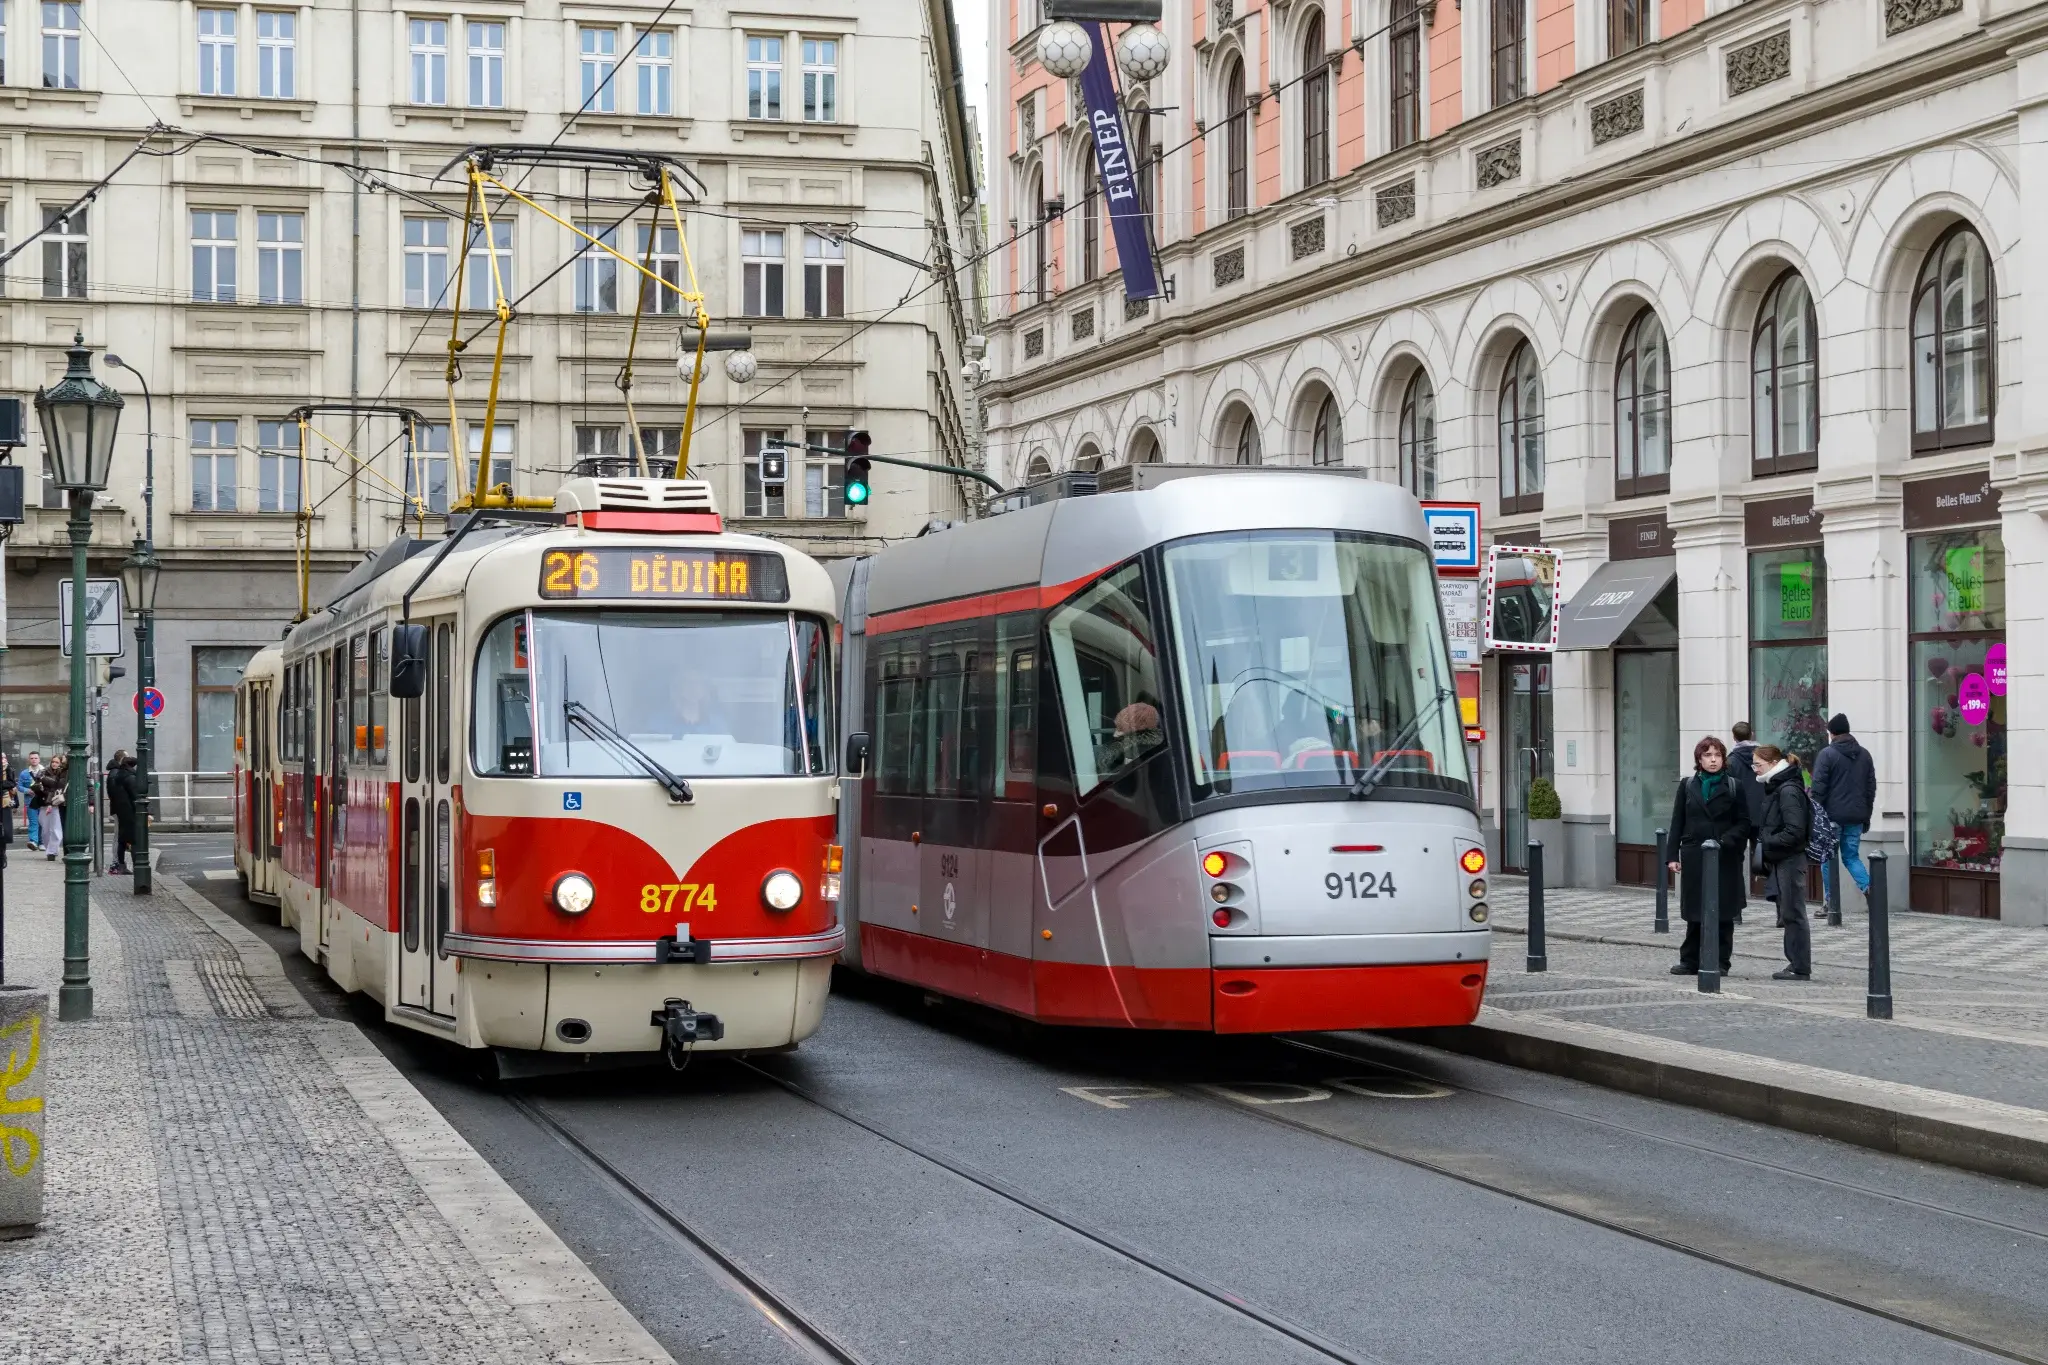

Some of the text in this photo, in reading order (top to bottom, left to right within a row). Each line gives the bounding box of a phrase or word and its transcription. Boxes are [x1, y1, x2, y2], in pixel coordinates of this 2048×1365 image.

[1093, 109, 1133, 202] FINEP
[1936, 492, 1982, 508] Belles Fleurs
[1772, 513, 1810, 527] Belles Fleurs
[1640, 530, 1658, 541] FINEP
[546, 552, 748, 594] 26 DĚDINA
[1948, 570, 1982, 591] Belles
[1590, 590, 1635, 607] FINEP
[1781, 580, 1811, 602] Belles
[1948, 592, 1982, 609] Fleurs
[1447, 608, 1455, 616] 26
[1781, 602, 1811, 620] Fleurs
[1967, 699, 1981, 710] 199
[941, 853, 958, 878] 9124
[1324, 871, 1397, 900] 9124
[640, 883, 718, 913] 8774
